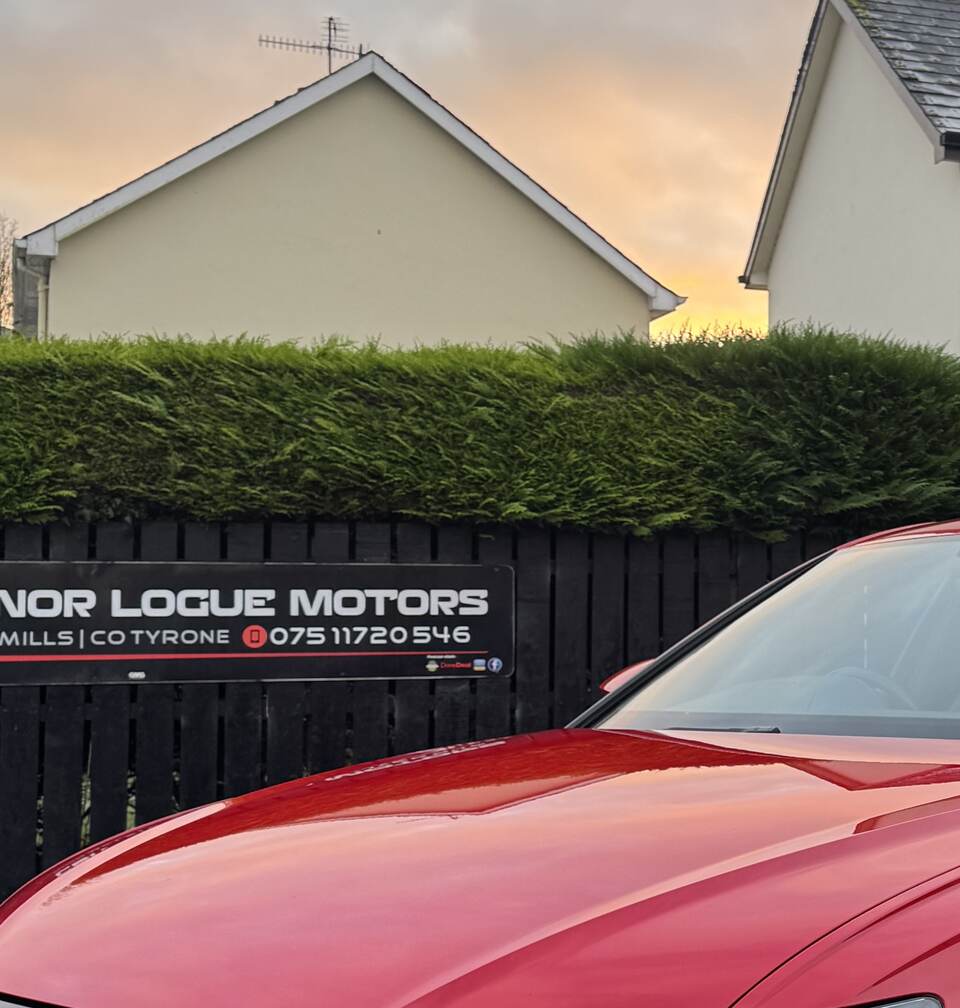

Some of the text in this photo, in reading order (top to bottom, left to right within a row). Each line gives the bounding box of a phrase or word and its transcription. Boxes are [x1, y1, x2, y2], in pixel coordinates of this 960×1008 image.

[0, 589, 488, 617] NOR LOGUE MOTORS
[91, 630, 126, 645] CO
[131, 629, 230, 644] TYRONE
